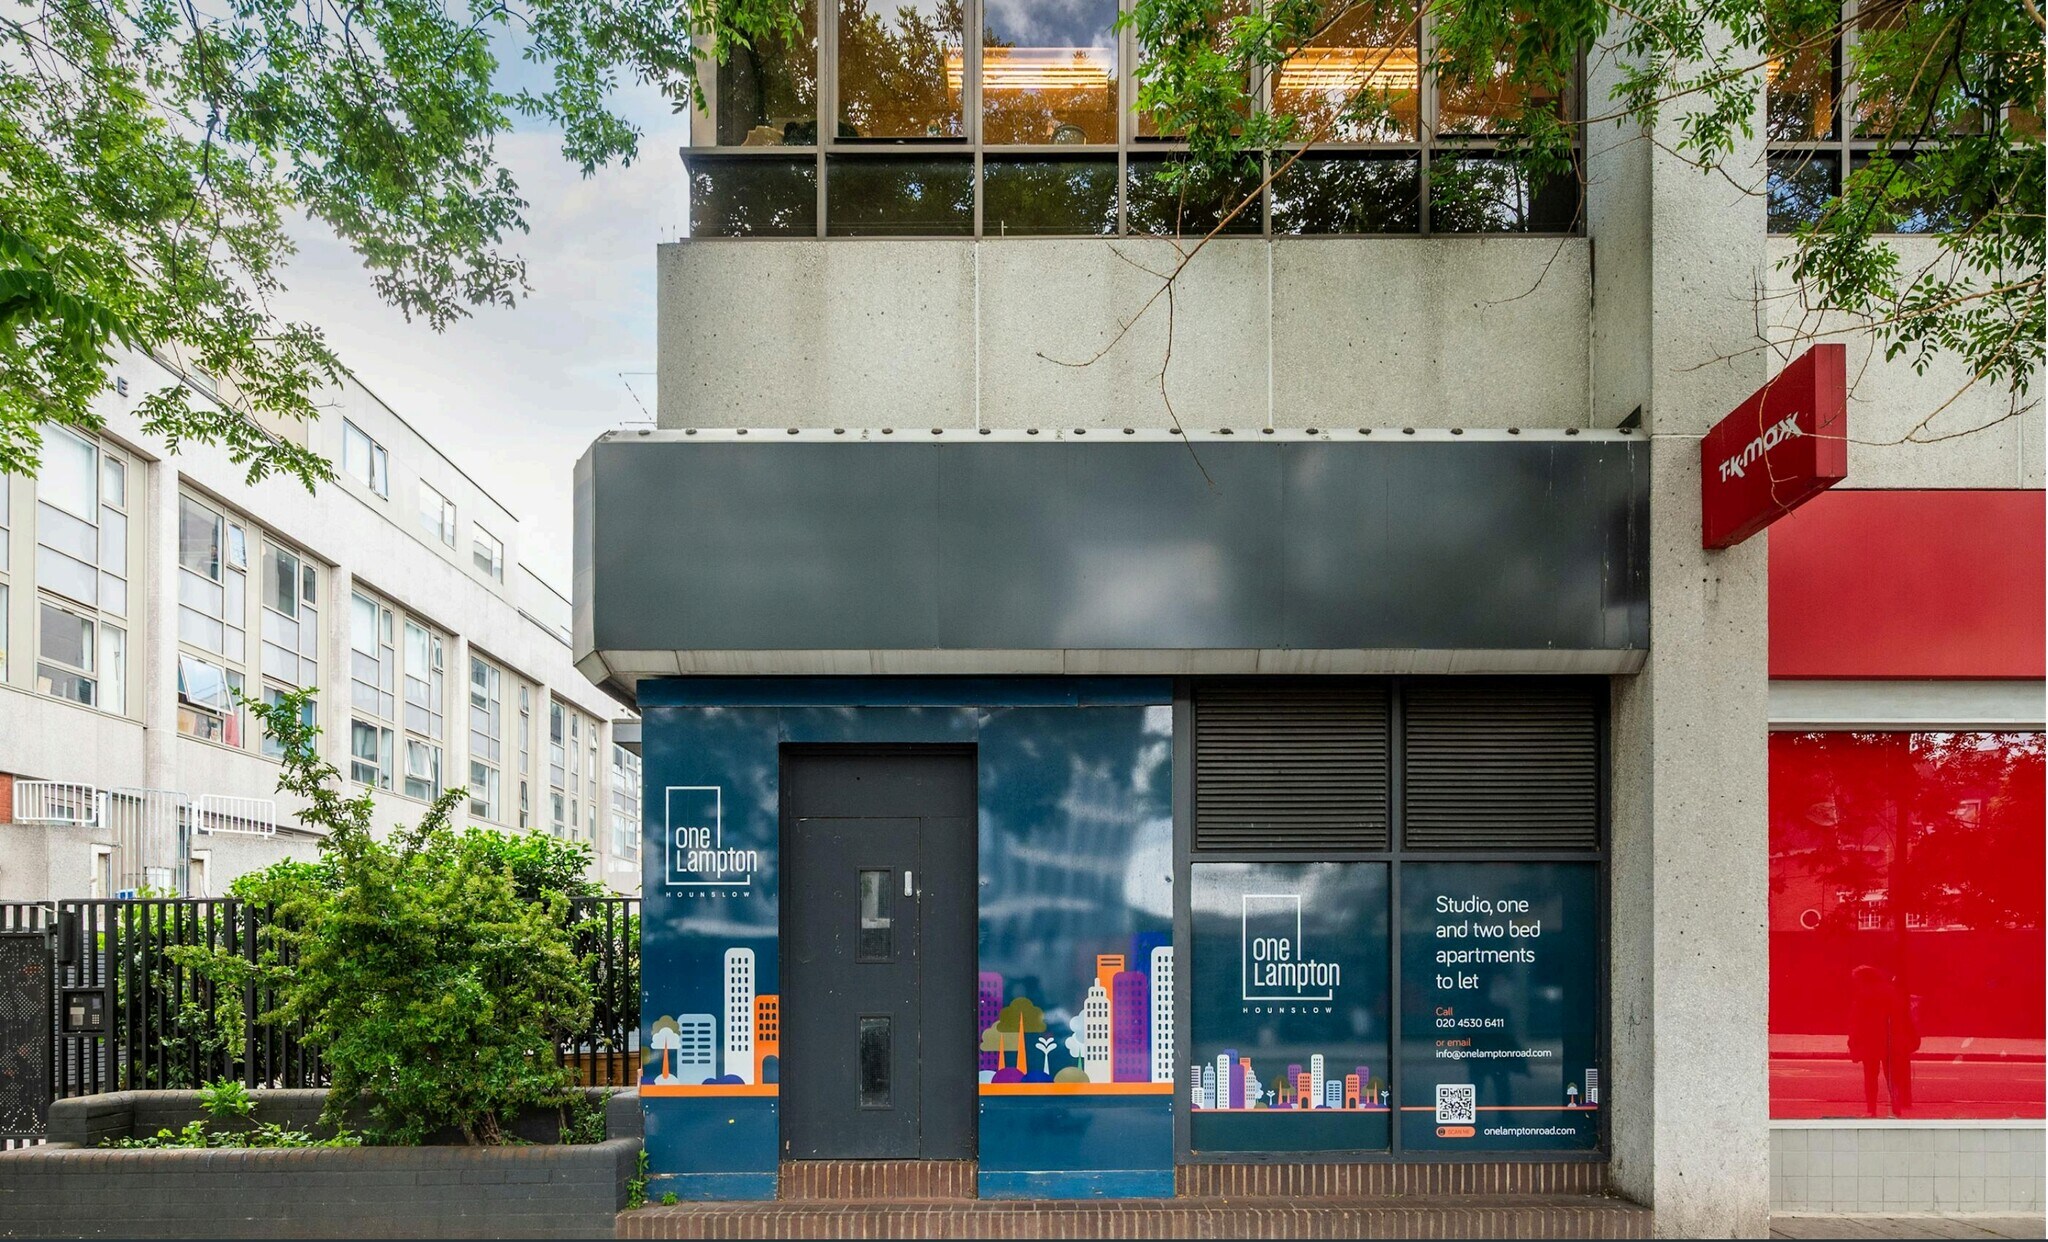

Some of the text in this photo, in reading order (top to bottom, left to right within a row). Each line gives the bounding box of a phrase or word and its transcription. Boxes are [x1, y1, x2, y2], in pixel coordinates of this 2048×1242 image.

[675, 826, 710, 848] one
[676, 846, 758, 879] Lampton
[1436, 894, 1529, 916] Studio, one
[1436, 919, 1541, 938] and two bed
[1253, 937, 1290, 961] one
[1436, 947, 1535, 967] apartments
[1253, 958, 1340, 994] Lampton
[1436, 971, 1479, 989] to let
[1435, 1006, 1453, 1016] Call
[1435, 1018, 1504, 1028] 020 4530 6411
[1447, 1037, 1471, 1047] email
[1435, 1048, 1552, 1060] info@onelamptonroad.com
[1483, 1126, 1576, 1138] onelamptonroad.com
